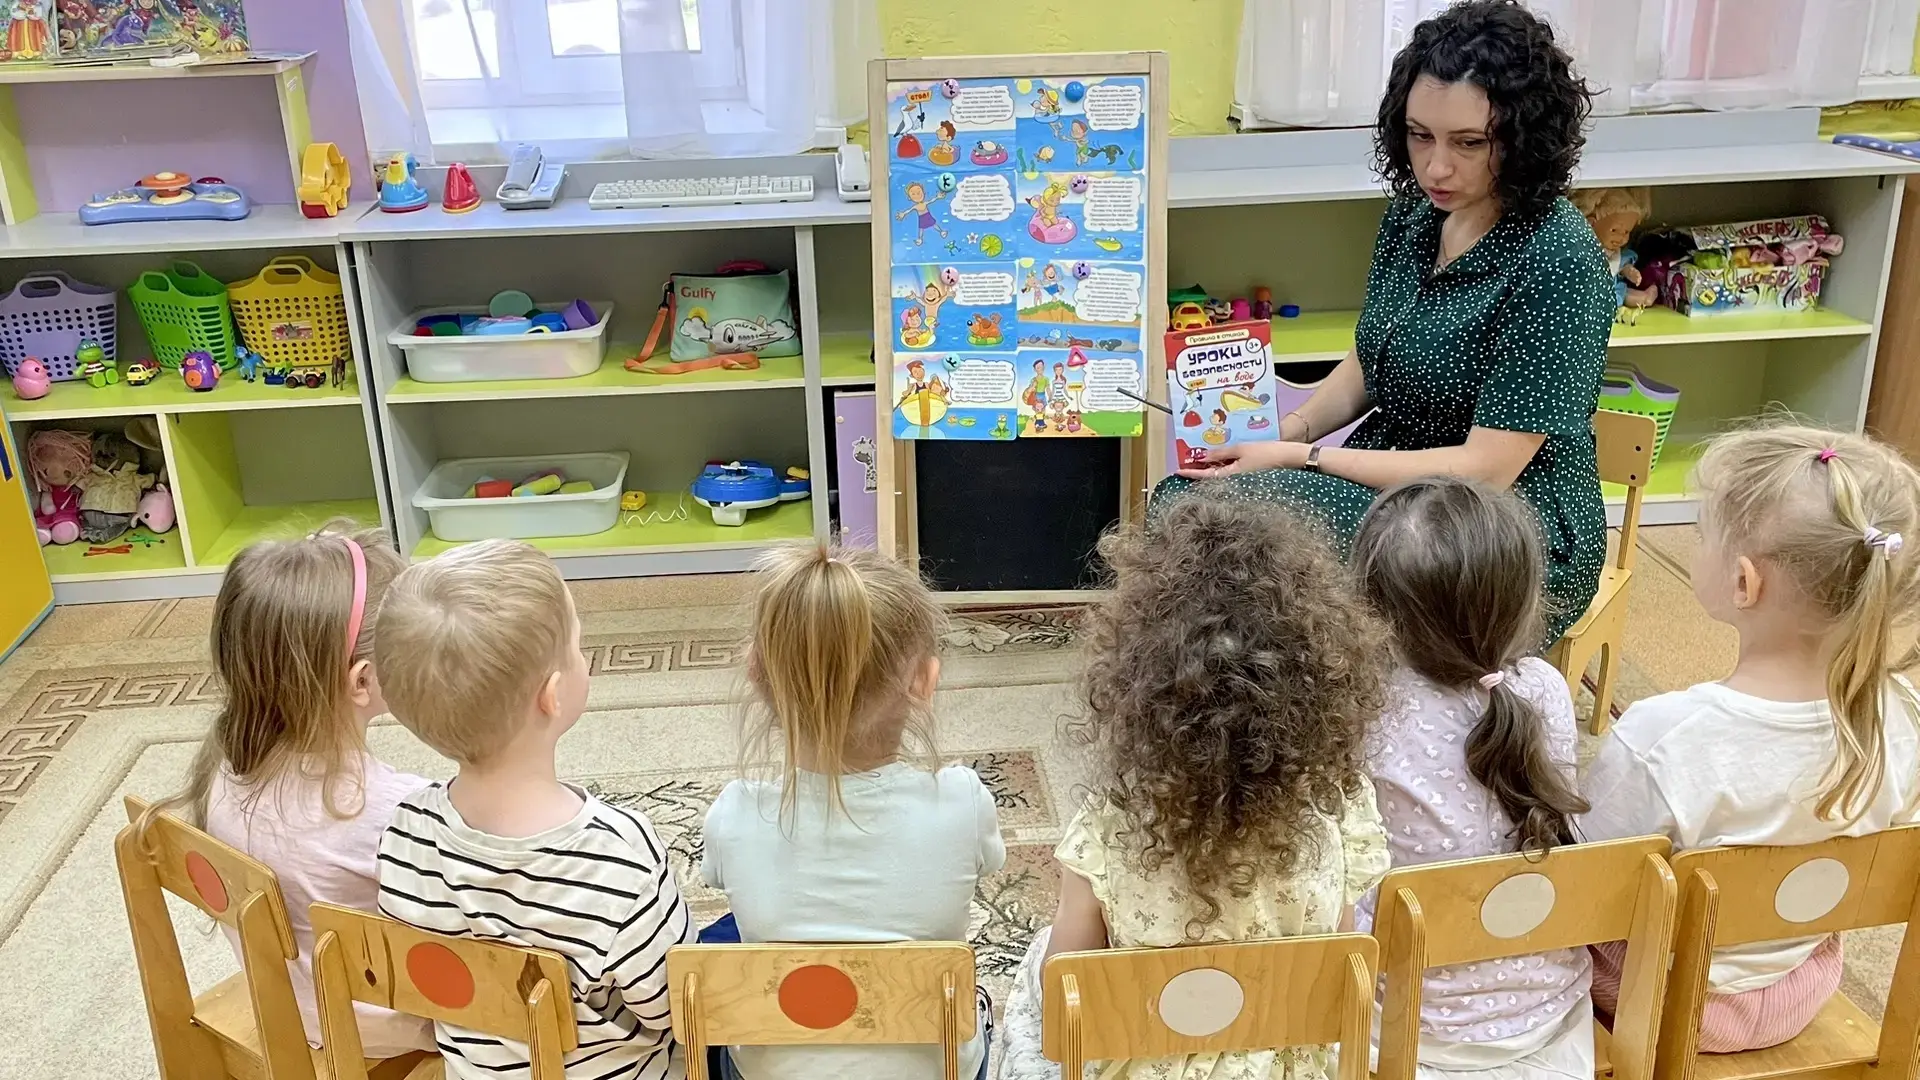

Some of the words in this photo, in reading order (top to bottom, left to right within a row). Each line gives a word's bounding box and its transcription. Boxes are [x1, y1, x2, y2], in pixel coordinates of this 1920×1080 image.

[680, 286, 717, 301] Gulfy
[1189, 334, 1216, 343] Правила
[1221, 331, 1245, 339] стихах
[1249, 341, 1259, 350] 3+
[1187, 345, 1242, 366] УРОКИ
[1216, 376, 1230, 385] на
[1234, 371, 1255, 382] воде
